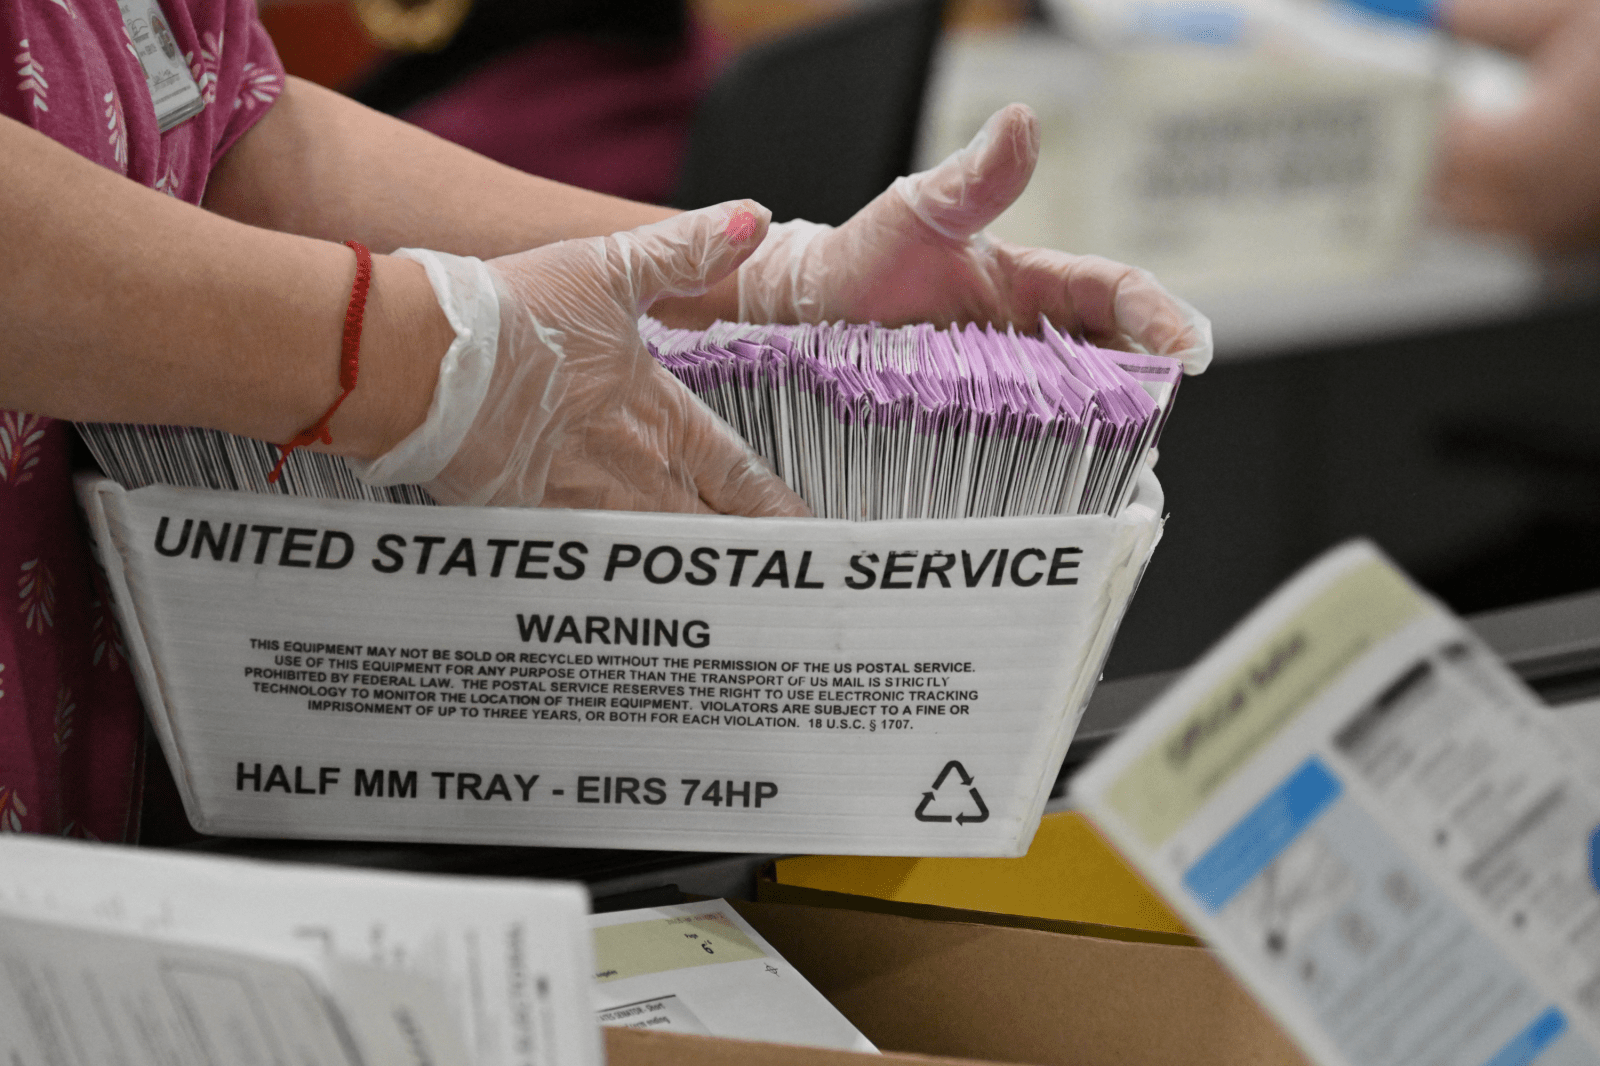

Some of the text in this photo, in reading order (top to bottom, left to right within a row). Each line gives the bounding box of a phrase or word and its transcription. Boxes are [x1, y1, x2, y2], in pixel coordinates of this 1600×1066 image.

[154, 516, 1084, 590] UNITED STATES POSTAL SERVICE
[515, 613, 710, 649] WARNING
[249, 638, 974, 674] THIS EQUIPMENT MAY NOT BE SOLD OR RECYCLED WITHOUT THE PERMISSION OF THE US POSTAL SERVICE.
[274, 655, 949, 688] USE OF THIS EQUIPMENT FOR ANY PURPOSE OTHER THAN THE TRANSPORT OF US MAIL IS STRICTLY
[244, 666, 978, 701] PROHIBITED BY FEDERAL LAW. THE POSTAL SERVICE RESERVES THE RIGHT TO USE ELECTRONIC TRACKING
[252, 681, 969, 716] TECHNOLOGY TO MONITOR THE LOCATION OF THEIR EQUIPMENT. VIOLATORS ARE SUBJECT TO A FINE OR
[308, 699, 913, 732] IMPRISONMENT OF UP TO THREE YEARS, OR BOTH FOR EACH VIOLATION. 18 U.S.C. § 1707.
[236, 761, 341, 796] HALF
[354, 768, 418, 799] MM
[430, 771, 540, 802] TRAY
[577, 775, 667, 806] EIRS
[681, 778, 779, 808] 74HP
